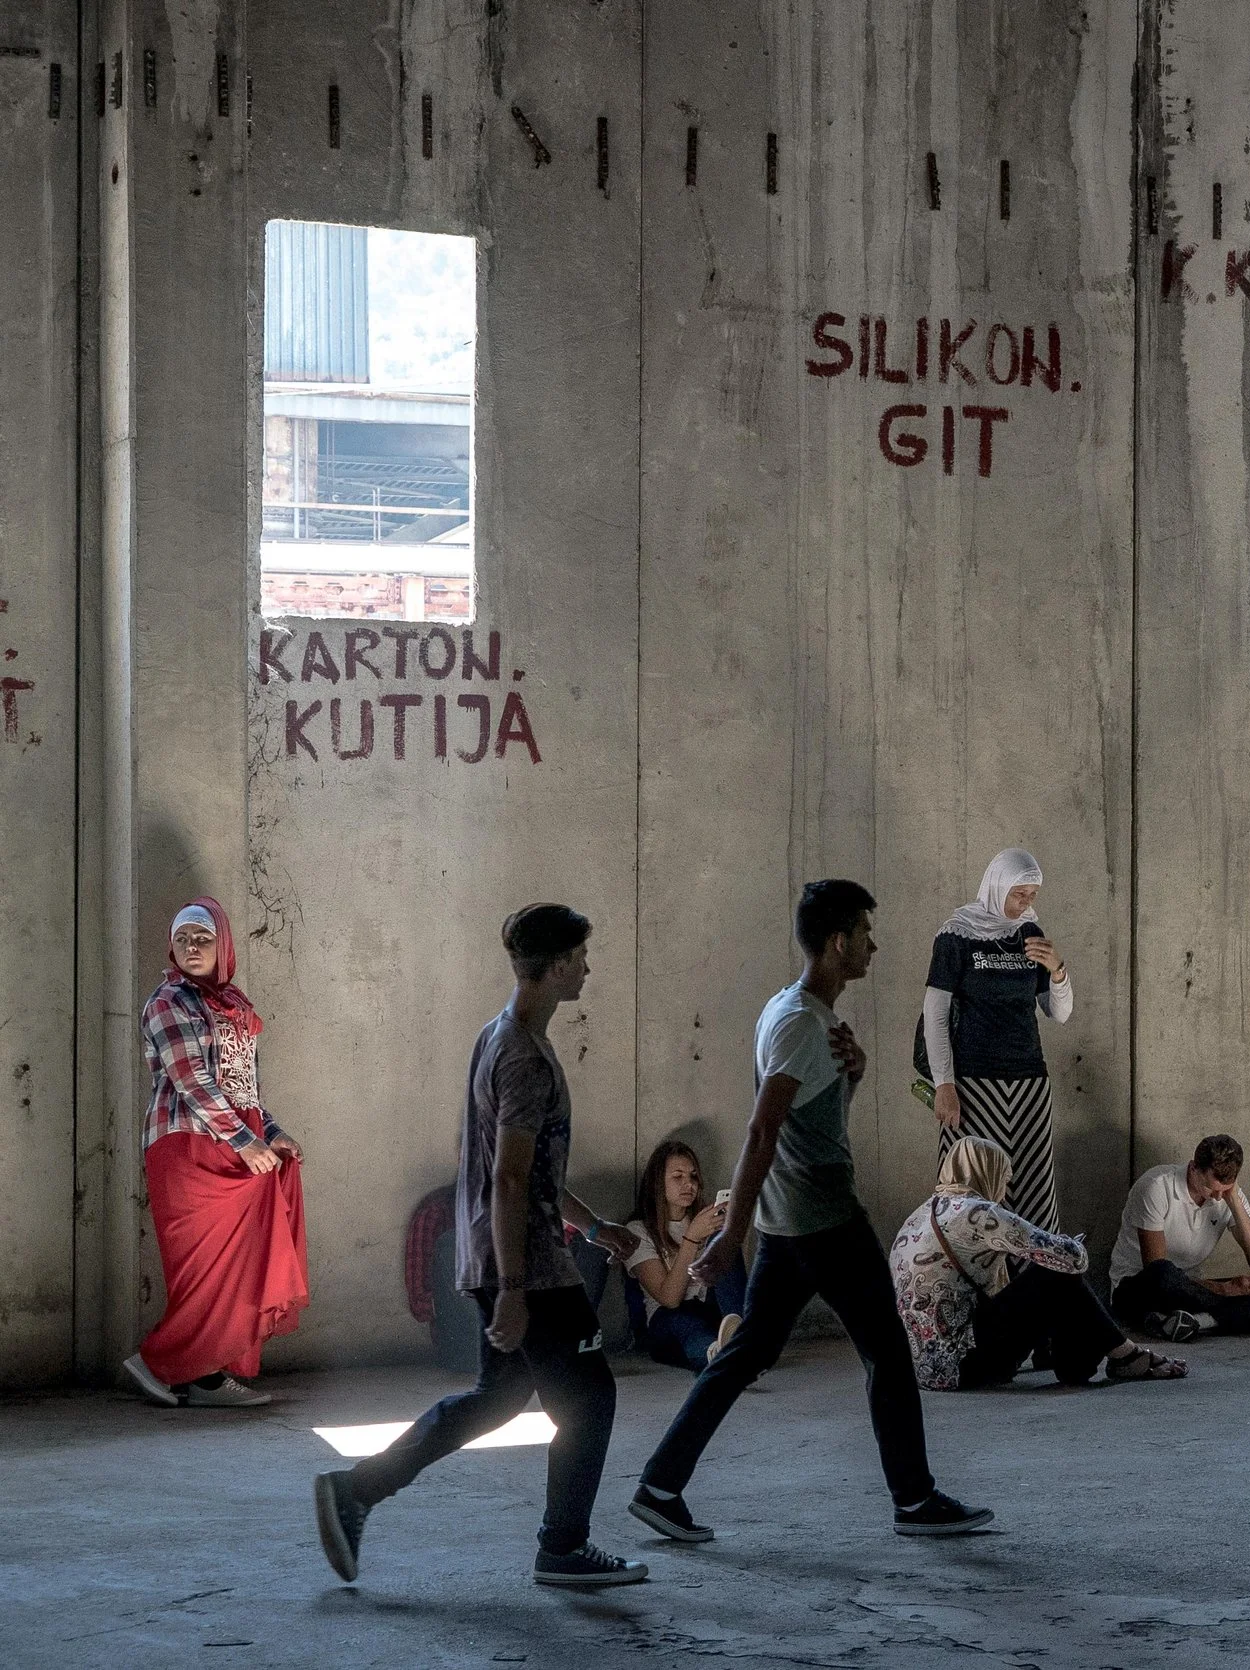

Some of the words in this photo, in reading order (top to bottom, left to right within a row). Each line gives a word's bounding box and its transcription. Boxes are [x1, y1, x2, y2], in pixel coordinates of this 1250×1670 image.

[1160, 240, 1216, 304] K.
[805, 312, 1081, 392] SILIKON.
[878, 404, 1012, 478] GIT
[259, 626, 525, 684] KARTON.
[285, 692, 542, 764] KUTIJA
